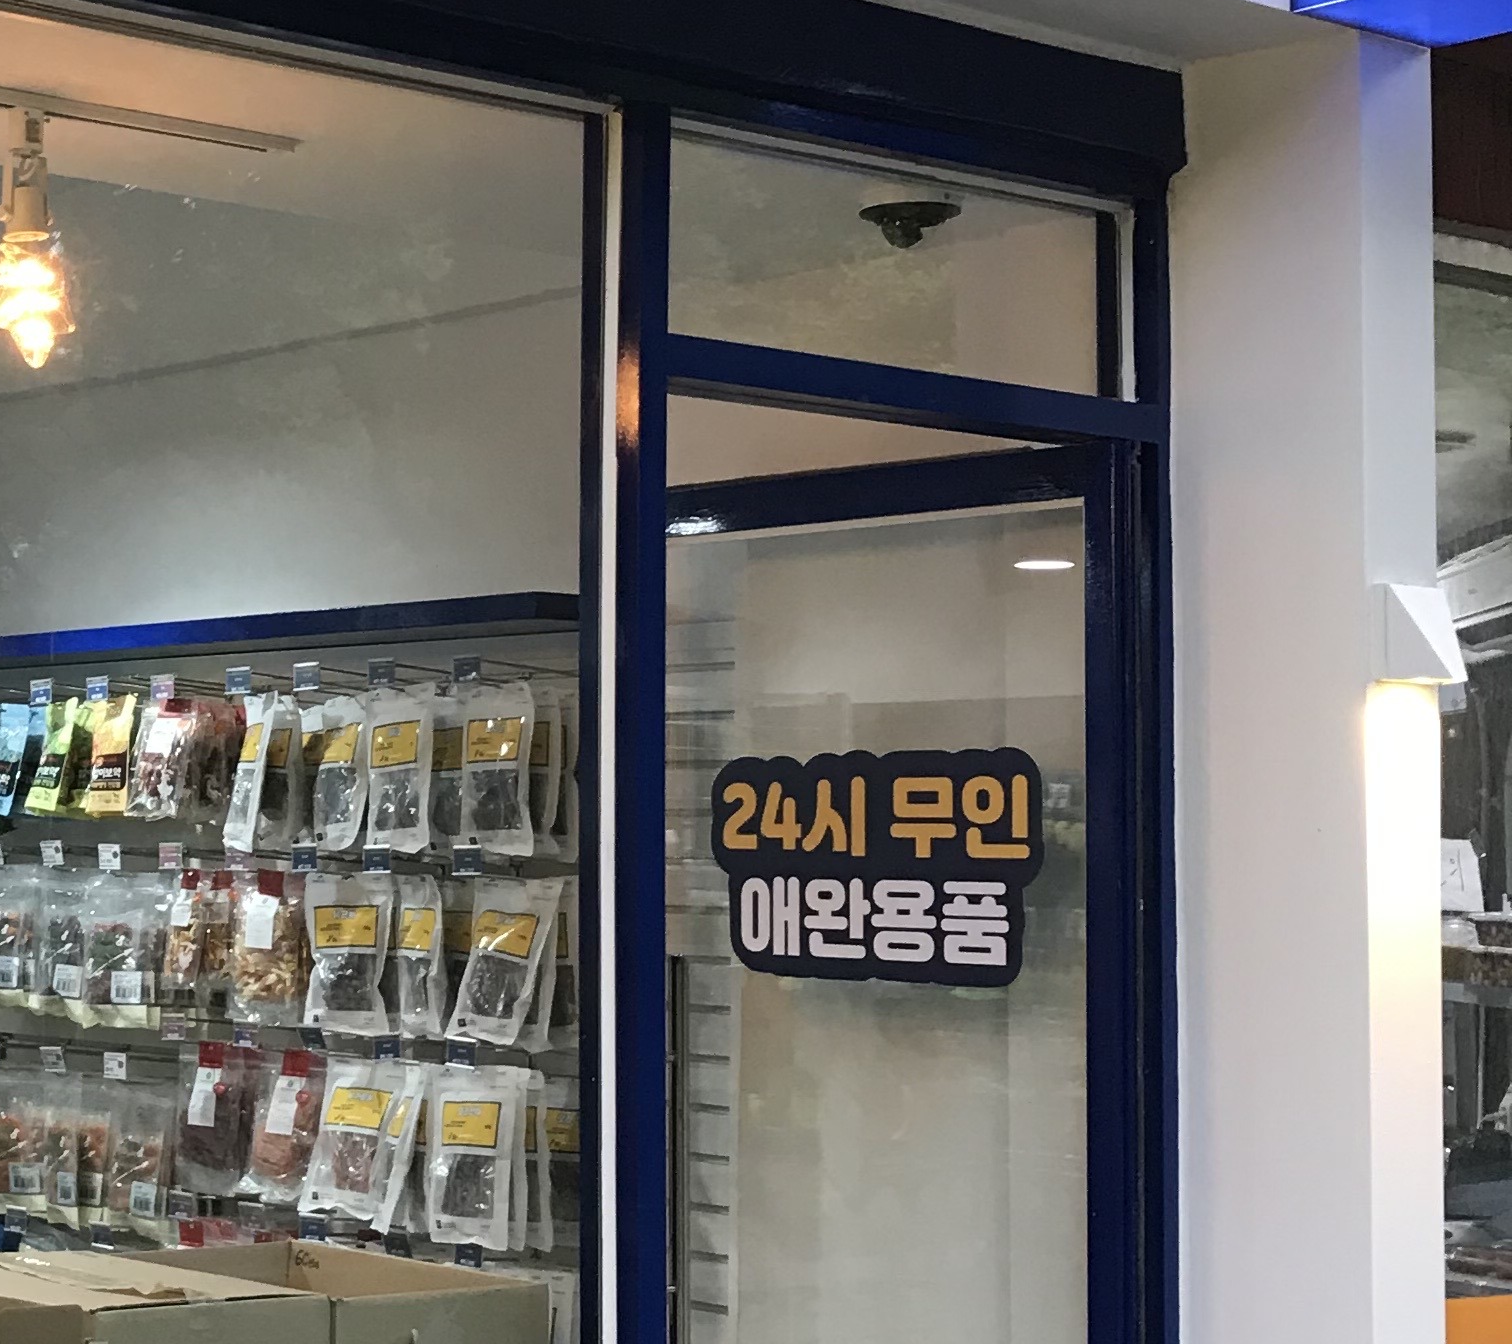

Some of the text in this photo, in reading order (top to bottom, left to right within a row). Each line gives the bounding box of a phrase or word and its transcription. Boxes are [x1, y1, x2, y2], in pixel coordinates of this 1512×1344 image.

[722, 774, 1031, 859] 24시 무인
[740, 875, 1010, 966] 애완용품
